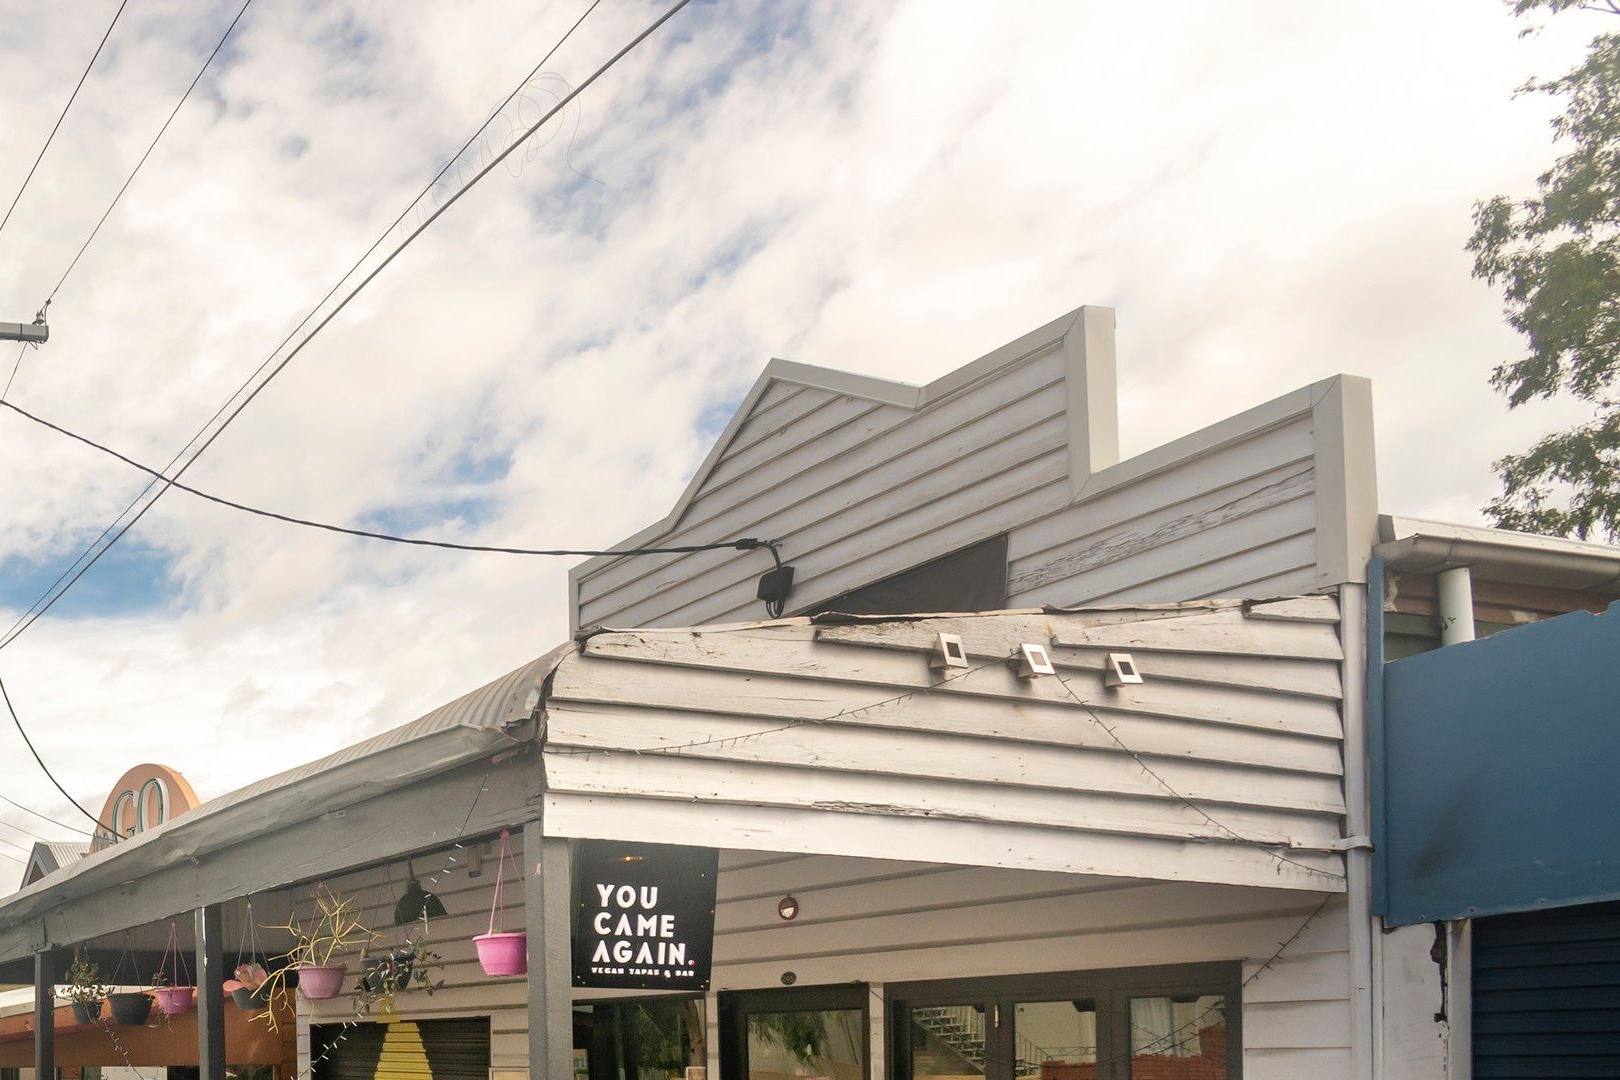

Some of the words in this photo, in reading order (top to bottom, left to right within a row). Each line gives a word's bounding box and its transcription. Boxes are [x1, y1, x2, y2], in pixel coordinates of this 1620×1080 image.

[596, 884, 658, 909] YOU
[594, 912, 675, 938] CAME
[592, 939, 697, 966] AGAIN.
[591, 967, 625, 975] VEGAN
[629, 968, 660, 976] TAPAS
